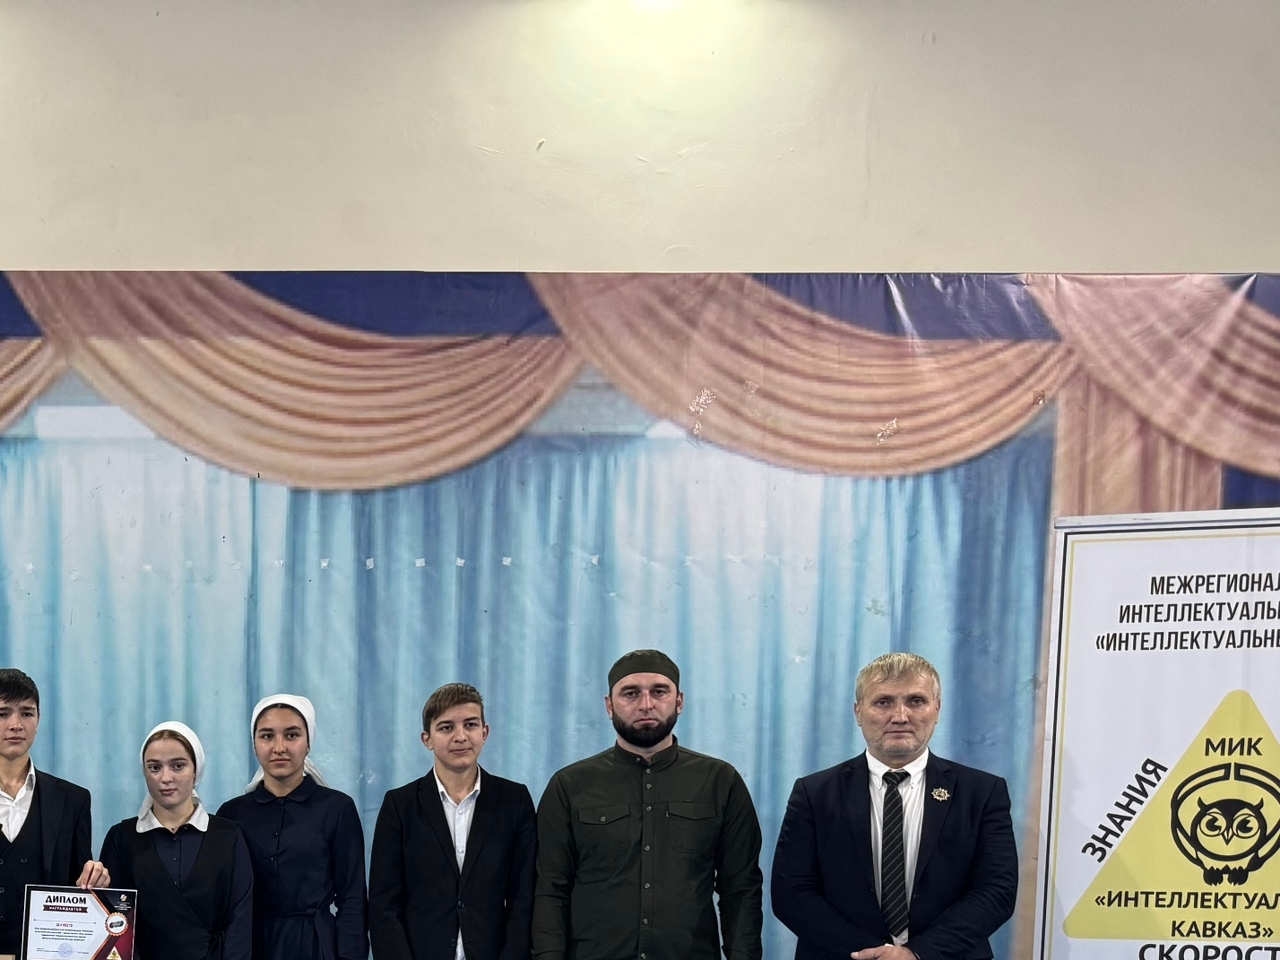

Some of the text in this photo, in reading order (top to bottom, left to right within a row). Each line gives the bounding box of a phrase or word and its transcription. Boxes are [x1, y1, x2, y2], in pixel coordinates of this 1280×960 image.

[1118, 600, 1280, 624] ИНТЕЛЛЕКТУАЛЬ
[1204, 736, 1264, 757] МИК
[1081, 757, 1169, 863] ЗНАНИЯ
[45, 894, 87, 905] ДИПЛОМ
[1170, 920, 1274, 939] КАВКАЗ»
